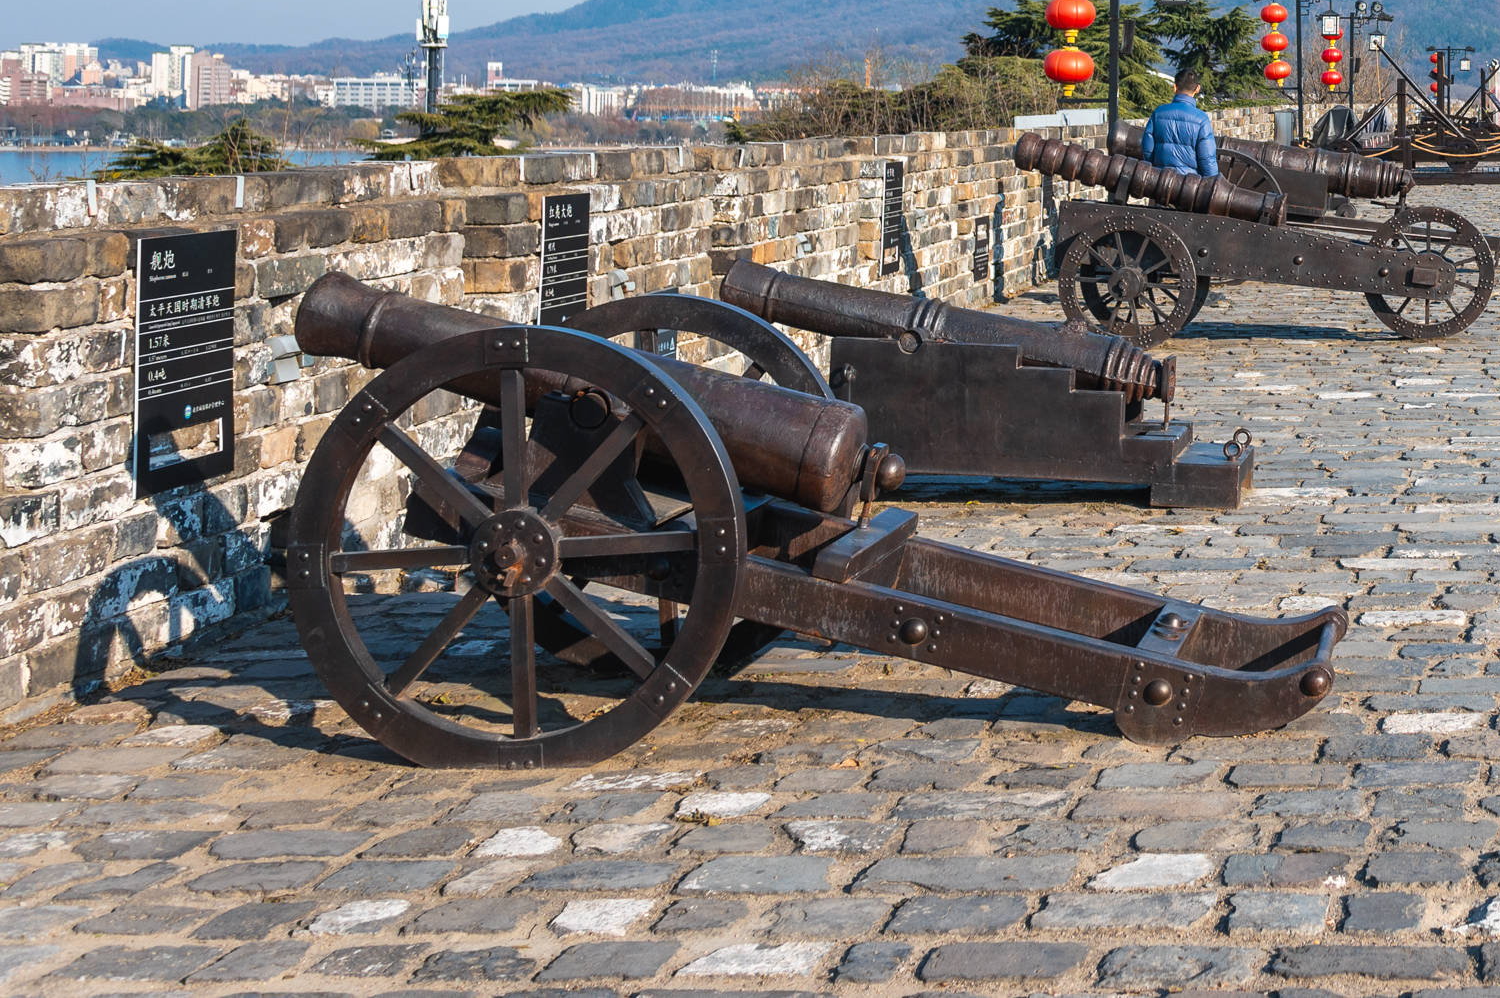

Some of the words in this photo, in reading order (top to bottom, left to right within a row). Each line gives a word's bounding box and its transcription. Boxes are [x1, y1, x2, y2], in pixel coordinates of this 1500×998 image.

[150, 250, 176, 271] 舰炮
[149, 295, 220, 317] 太平天国时期清军炮
[149, 334, 170, 349] 1.57米
